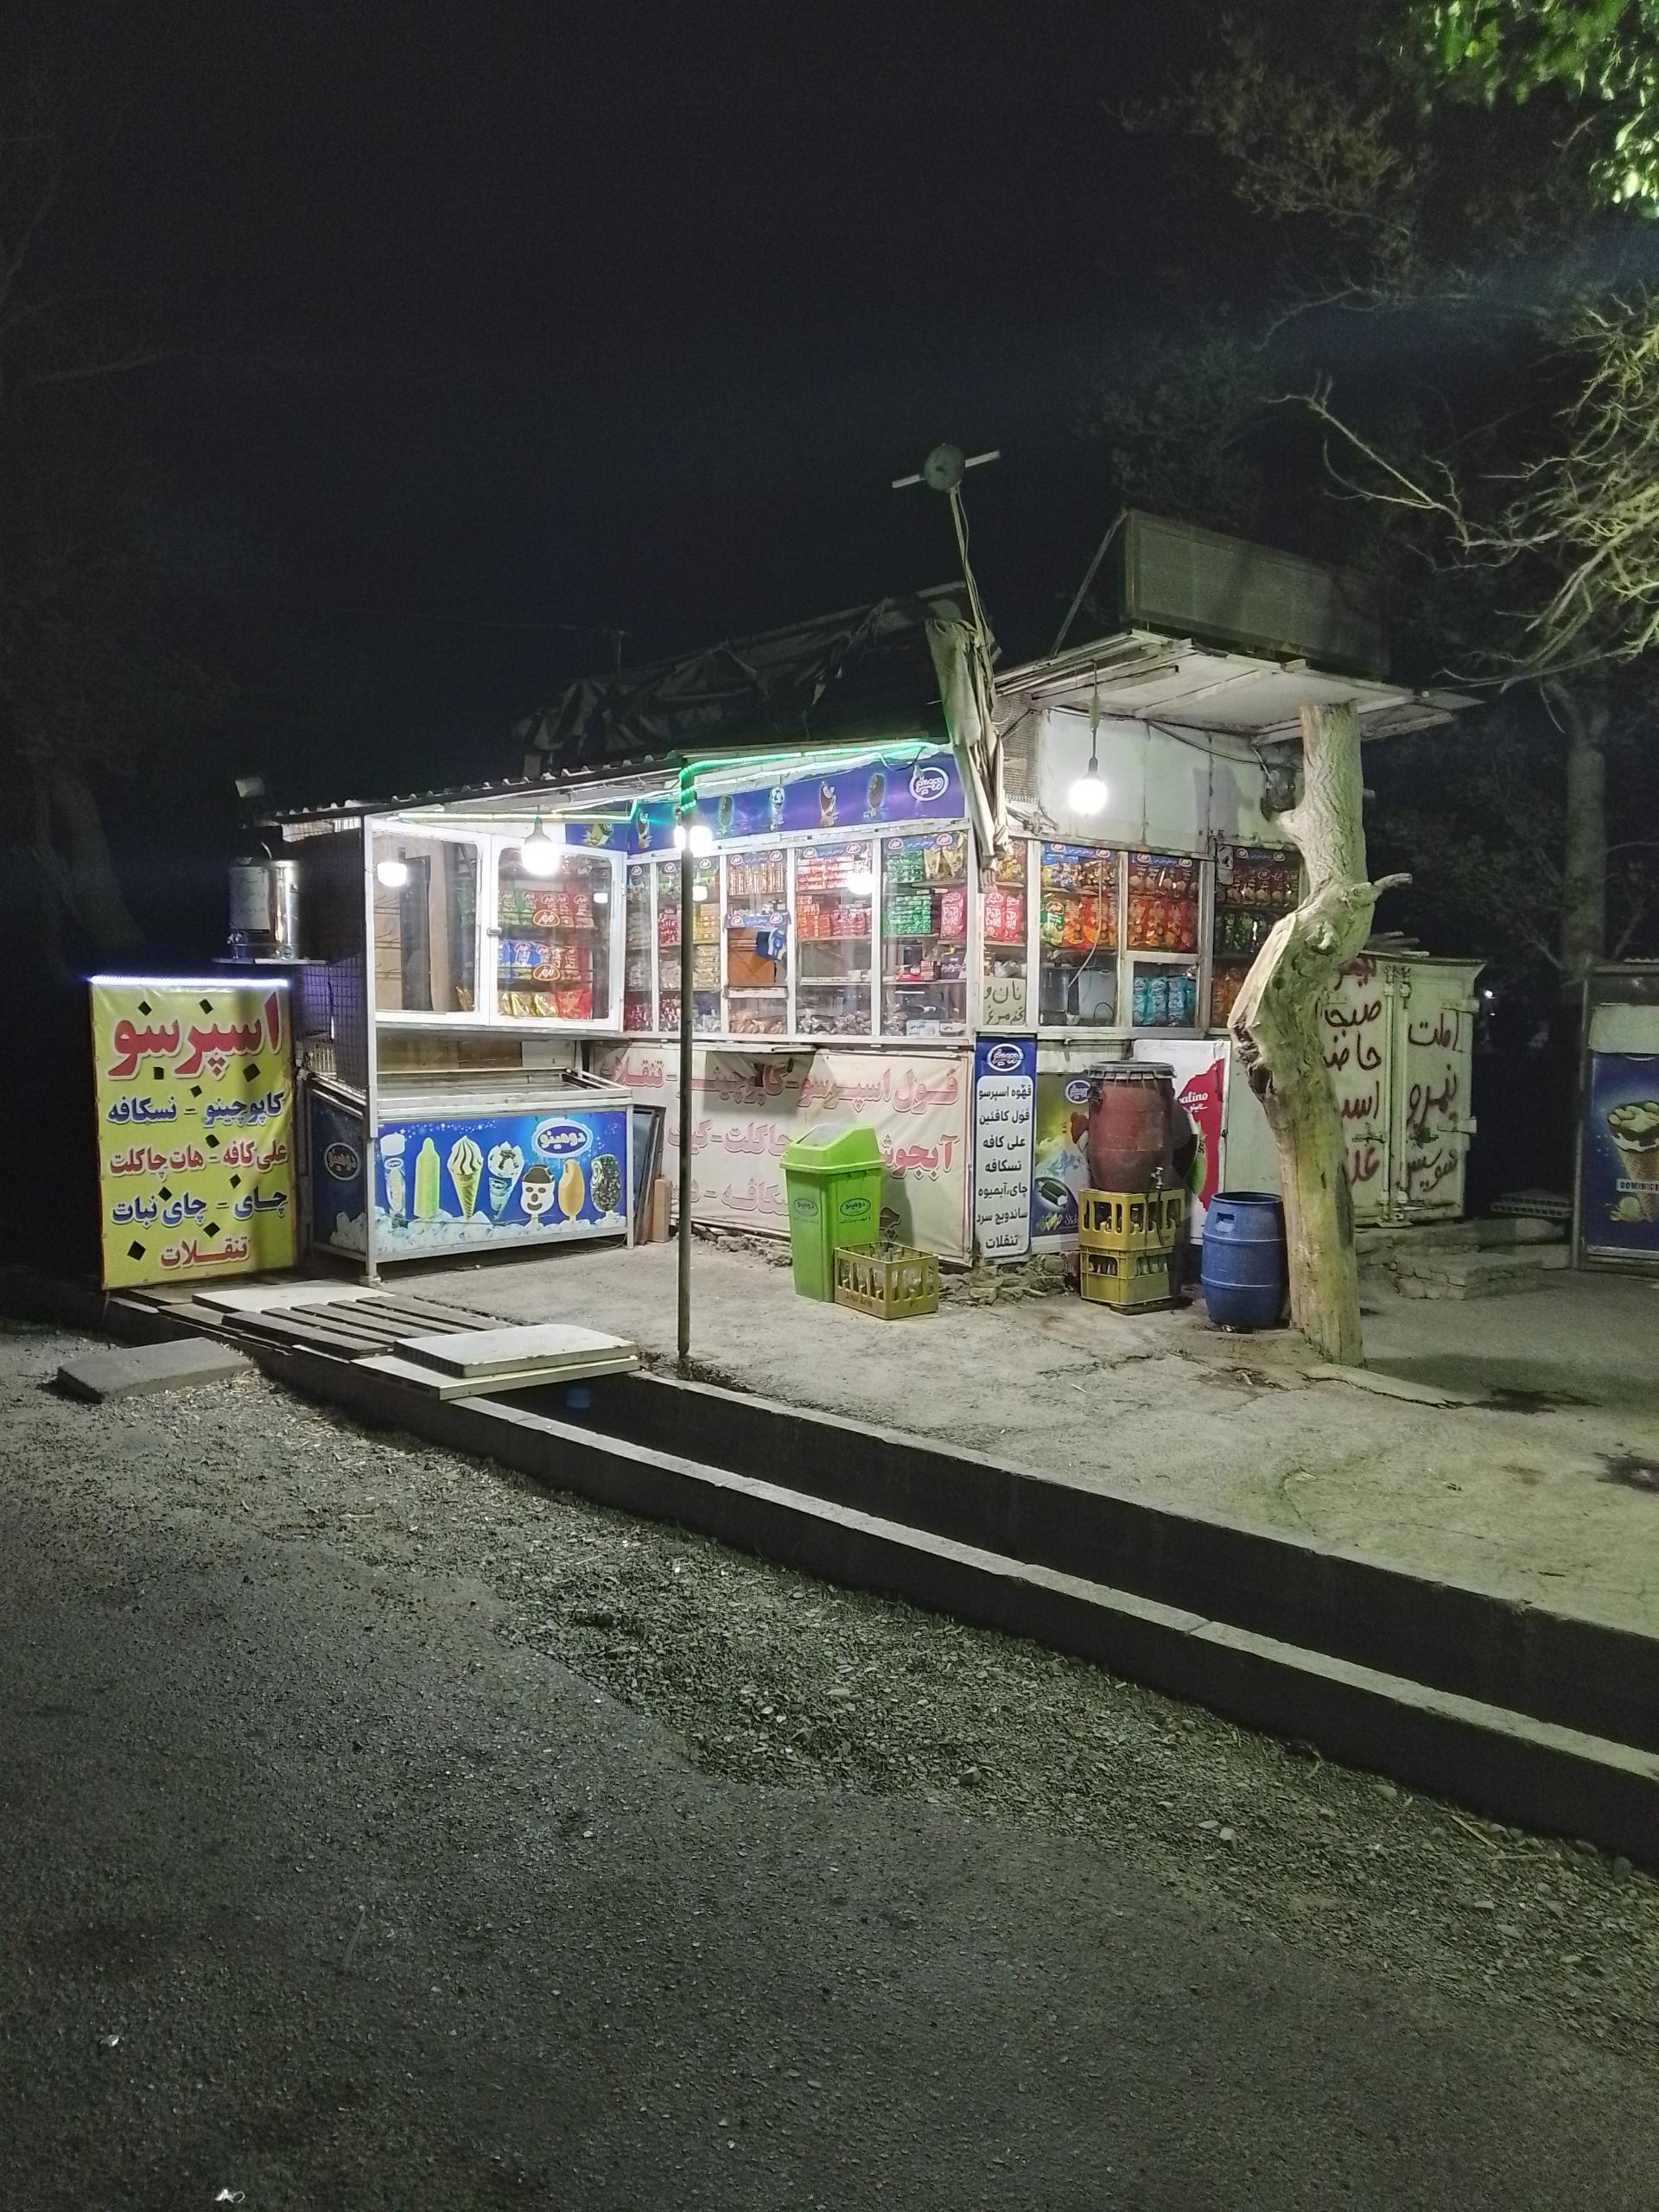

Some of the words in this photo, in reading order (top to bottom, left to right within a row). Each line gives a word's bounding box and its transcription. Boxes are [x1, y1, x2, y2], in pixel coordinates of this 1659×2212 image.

[993, 980, 1021, 1004] نان
[985, 1004, 1010, 1026] مرغ
[108, 992, 282, 1077] اسپرسو
[798, 1068, 891, 1113] اسپرسو
[893, 1068, 959, 1115] فول
[978, 1085, 1009, 1102] اسپرسو
[1010, 1084, 1032, 1100] قهوه
[108, 1096, 177, 1122] نسکافه
[203, 1091, 285, 1127] کاپوچینو
[979, 1109, 1009, 1125] کافئین
[1011, 1109, 1030, 1124] فول
[222, 1140, 256, 1164] کافه
[539, 1130, 587, 1150] دومینو
[982, 1135, 1004, 1148] کافه
[1007, 1135, 1026, 1151] علی
[109, 1147, 168, 1181] چاکلت
[170, 1145, 204, 1170] هات
[985, 1158, 1022, 1173] نسکافه
[111, 1193, 158, 1228] نبات
[162, 1192, 207, 1224] چای
[234, 1186, 288, 1219] چای
[976, 1213, 993, 1225] سرد
[995, 1207, 1028, 1225] ساندویچ
[160, 1236, 251, 1268] تنقلات
[985, 1234, 1019, 1249] تنقلات
